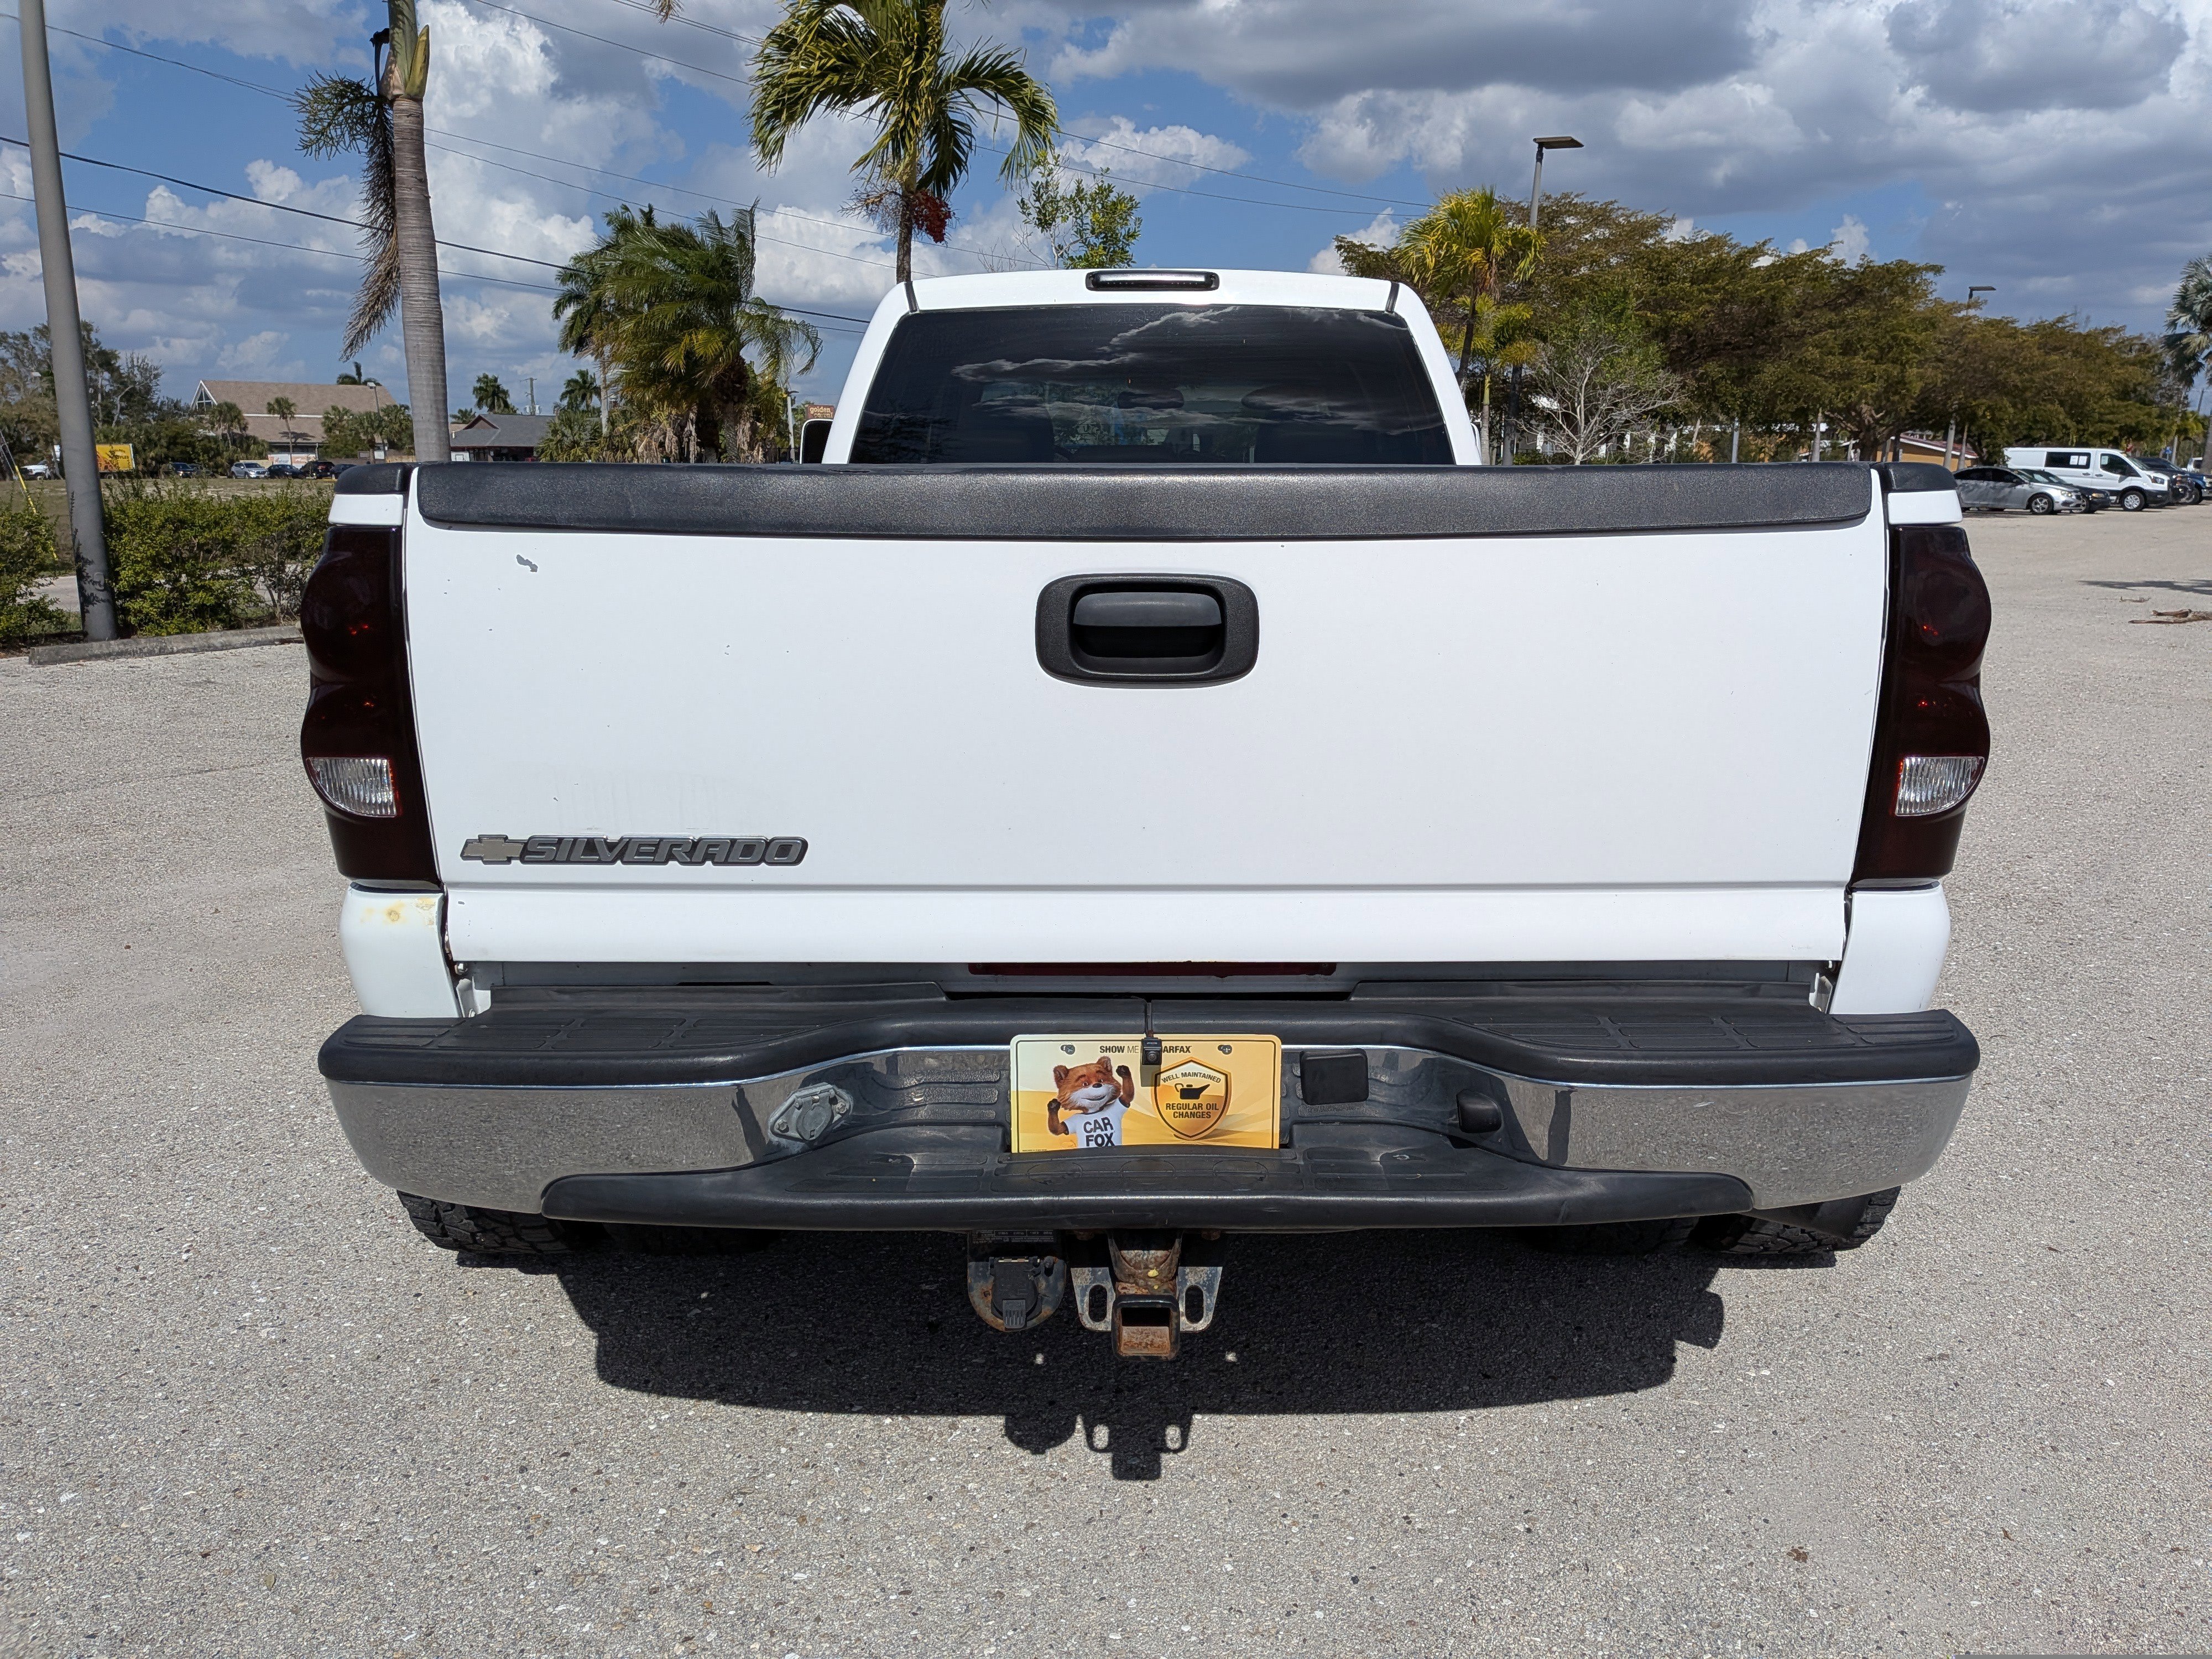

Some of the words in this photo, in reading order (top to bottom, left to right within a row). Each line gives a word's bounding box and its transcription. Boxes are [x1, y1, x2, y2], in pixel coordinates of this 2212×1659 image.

[523, 837, 805, 863] SILVERADO
[1099, 1045, 1125, 1053] SHOW
[1127, 1045, 1139, 1053] ME
[1162, 1045, 1192, 1053] ARFAX
[1161, 1073, 1180, 1083] WELL
[1181, 1072, 1221, 1083] MAINTAINED
[1083, 1117, 1114, 1134] CAR
[1086, 1132, 1115, 1147] FOX
